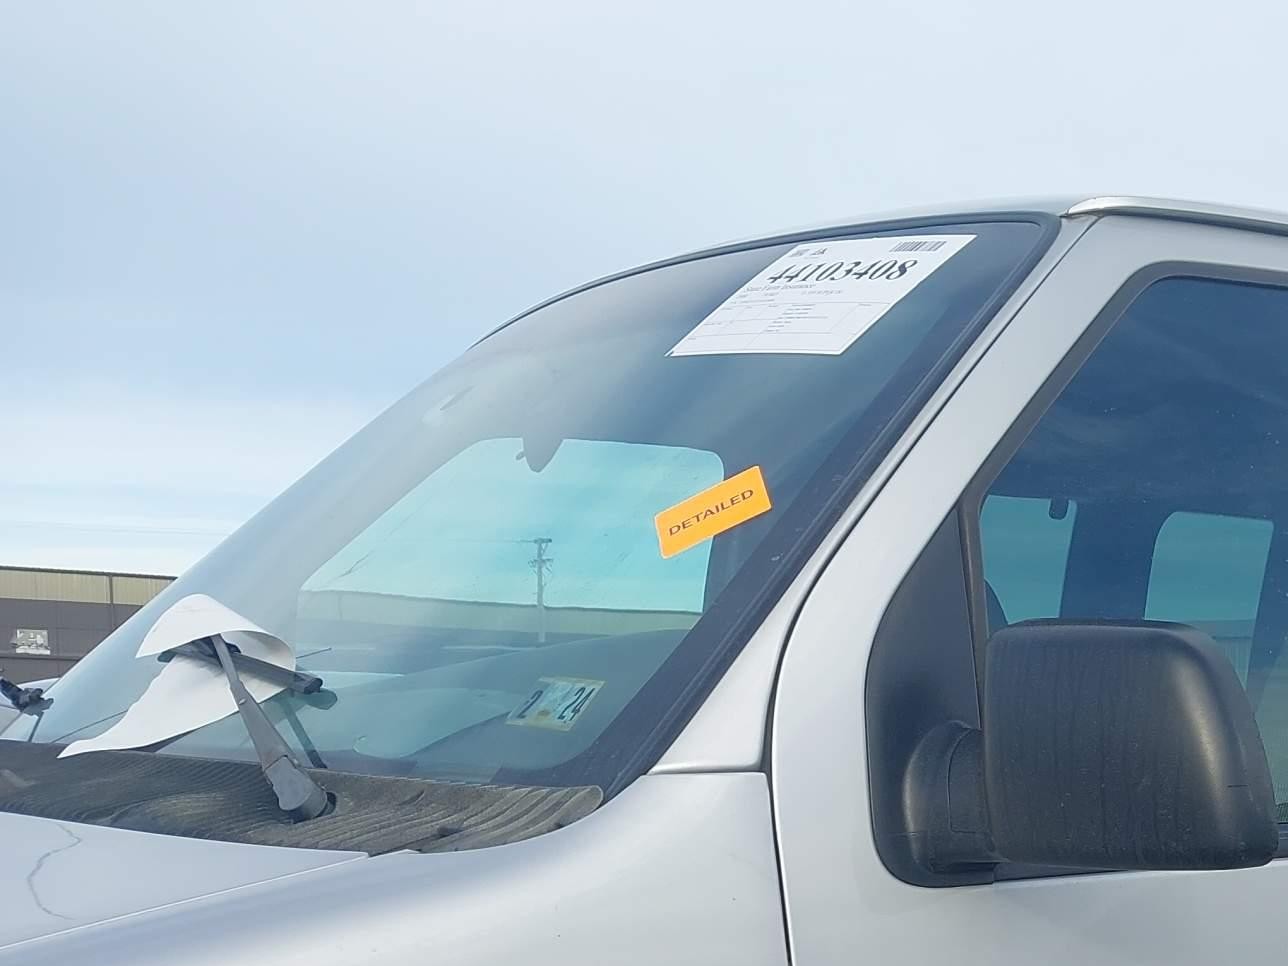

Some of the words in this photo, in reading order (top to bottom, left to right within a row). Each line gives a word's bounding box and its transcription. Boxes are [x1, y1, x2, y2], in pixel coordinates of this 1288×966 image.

[767, 259, 918, 283] 44103408
[668, 489, 754, 536] DETAILED
[557, 687, 596, 721] 24
